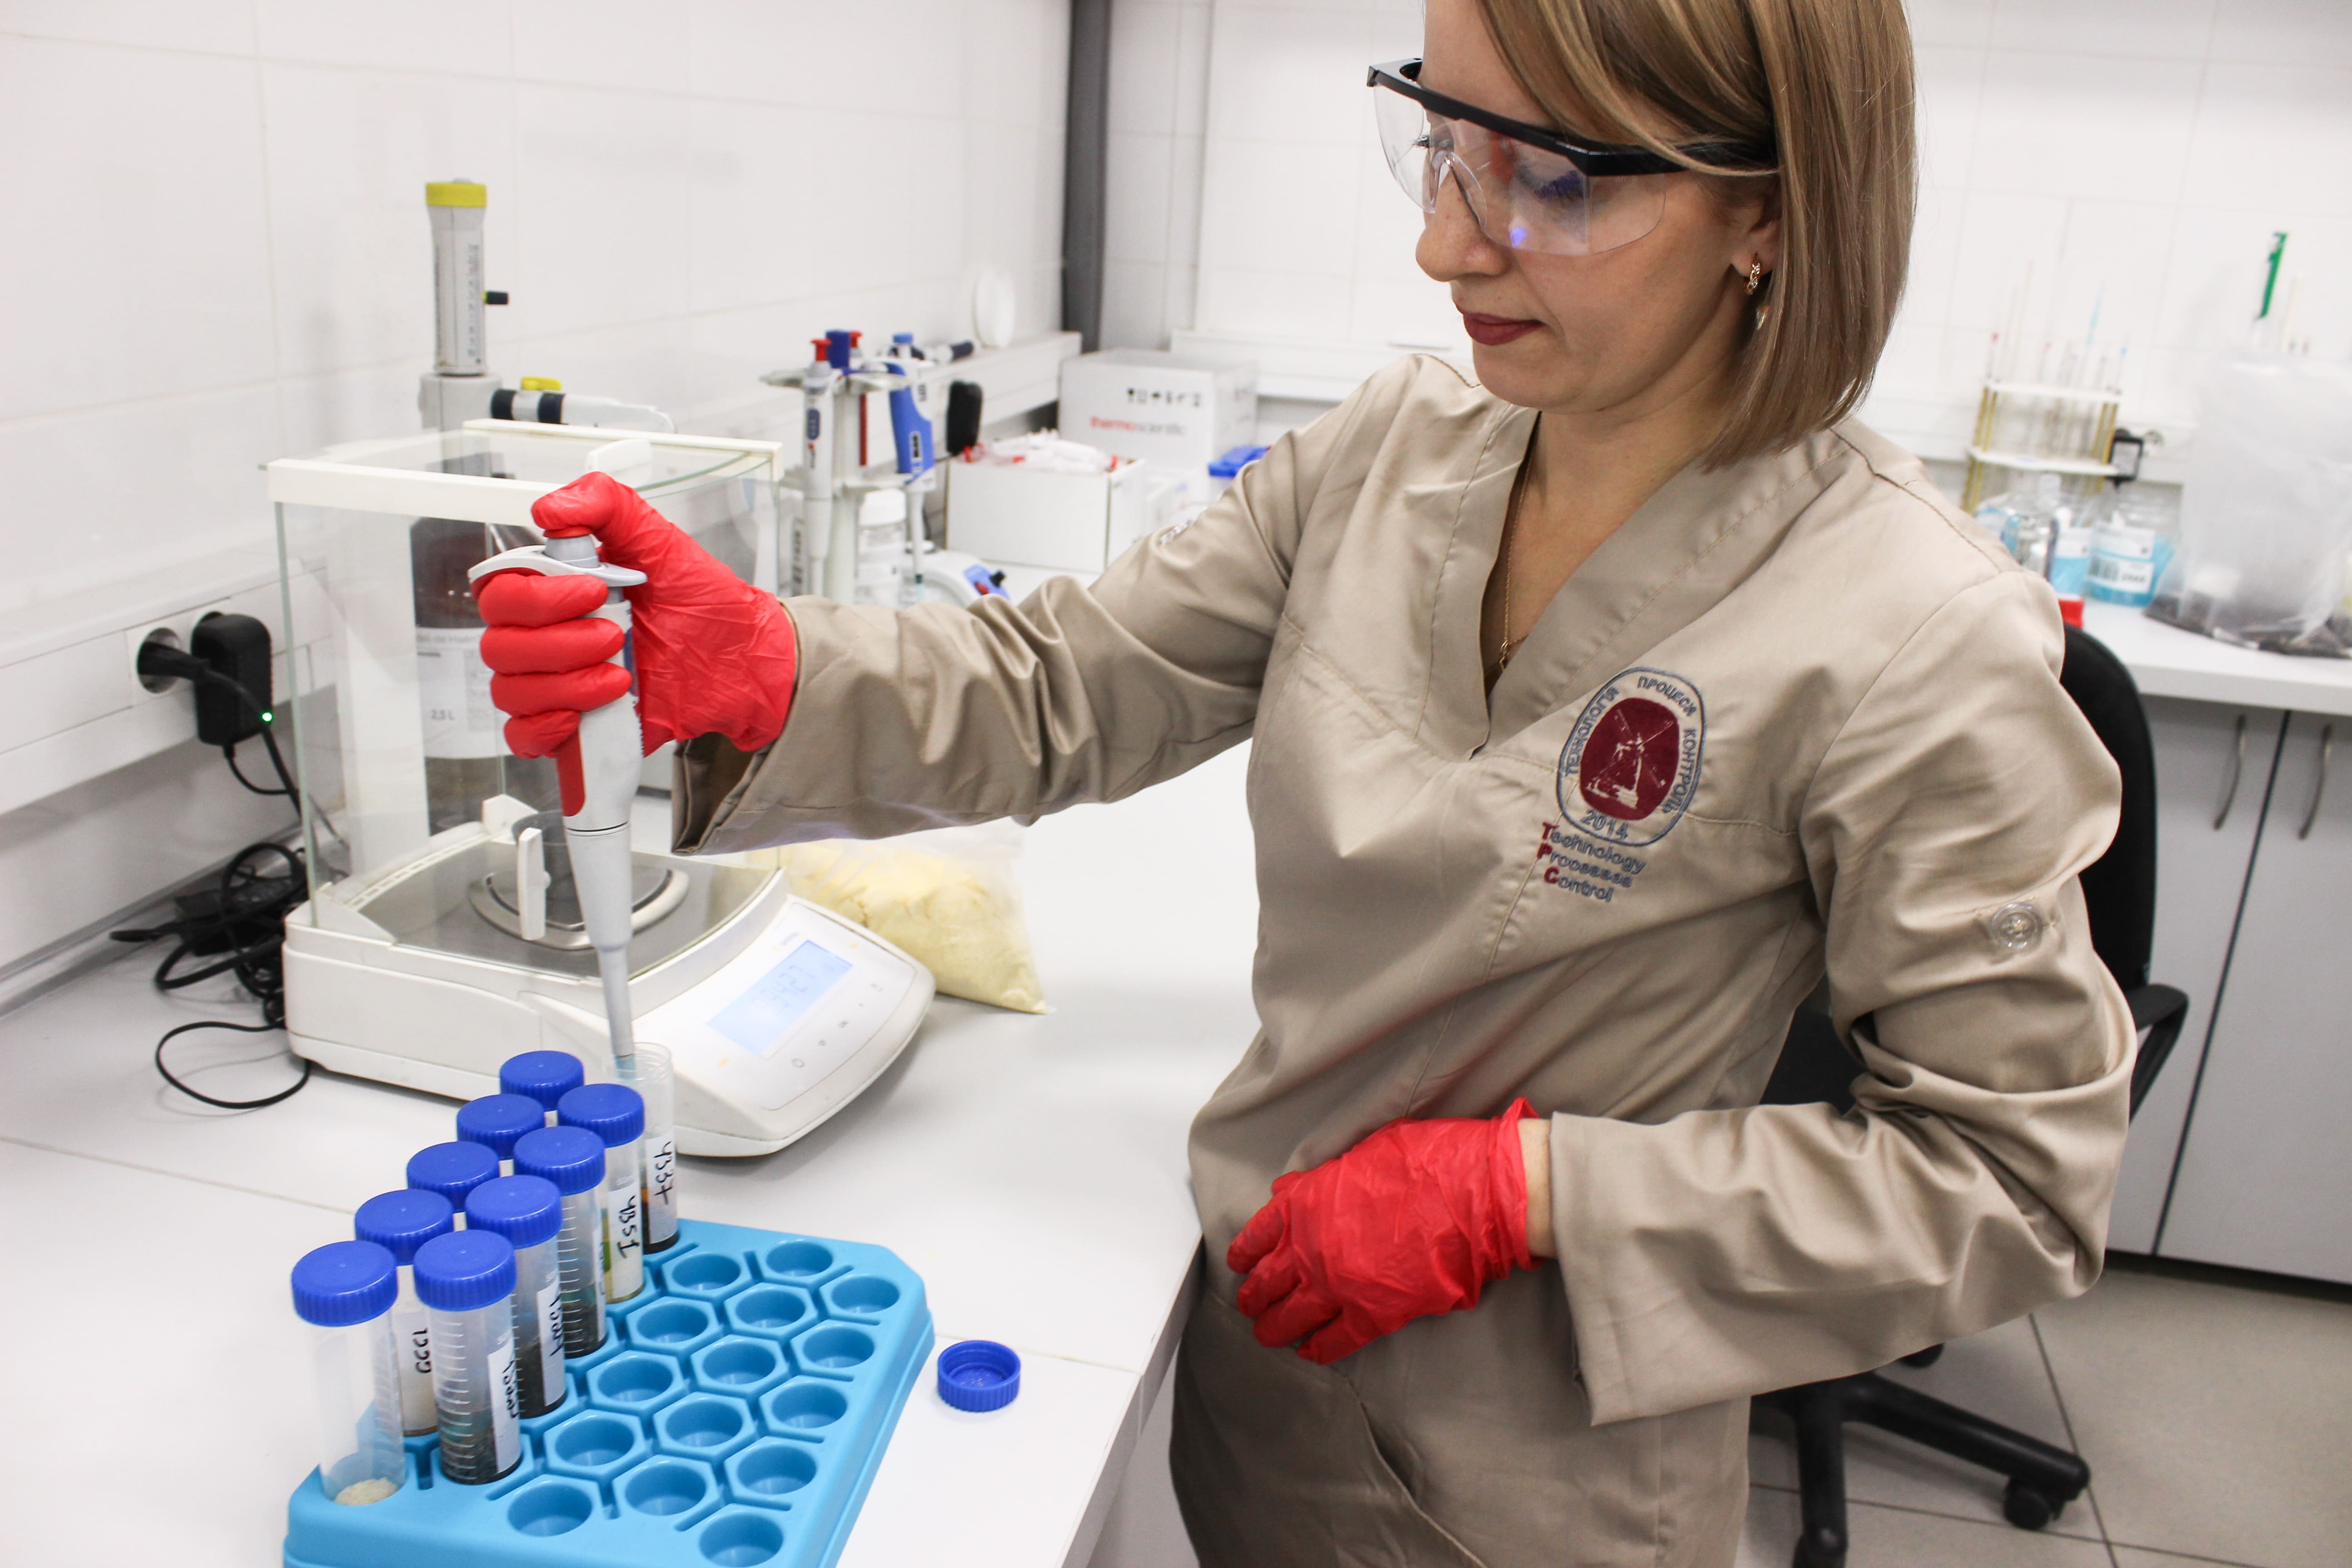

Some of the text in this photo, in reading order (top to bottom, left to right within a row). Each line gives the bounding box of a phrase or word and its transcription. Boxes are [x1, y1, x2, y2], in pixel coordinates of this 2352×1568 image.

[1662, 728, 1697, 814] КОНТРОЛЬ
[1542, 821, 1647, 875] Technology
[1581, 808, 1630, 840] 2014
[1544, 866, 1615, 902] Control
[617, 1195, 641, 1259] 4351
